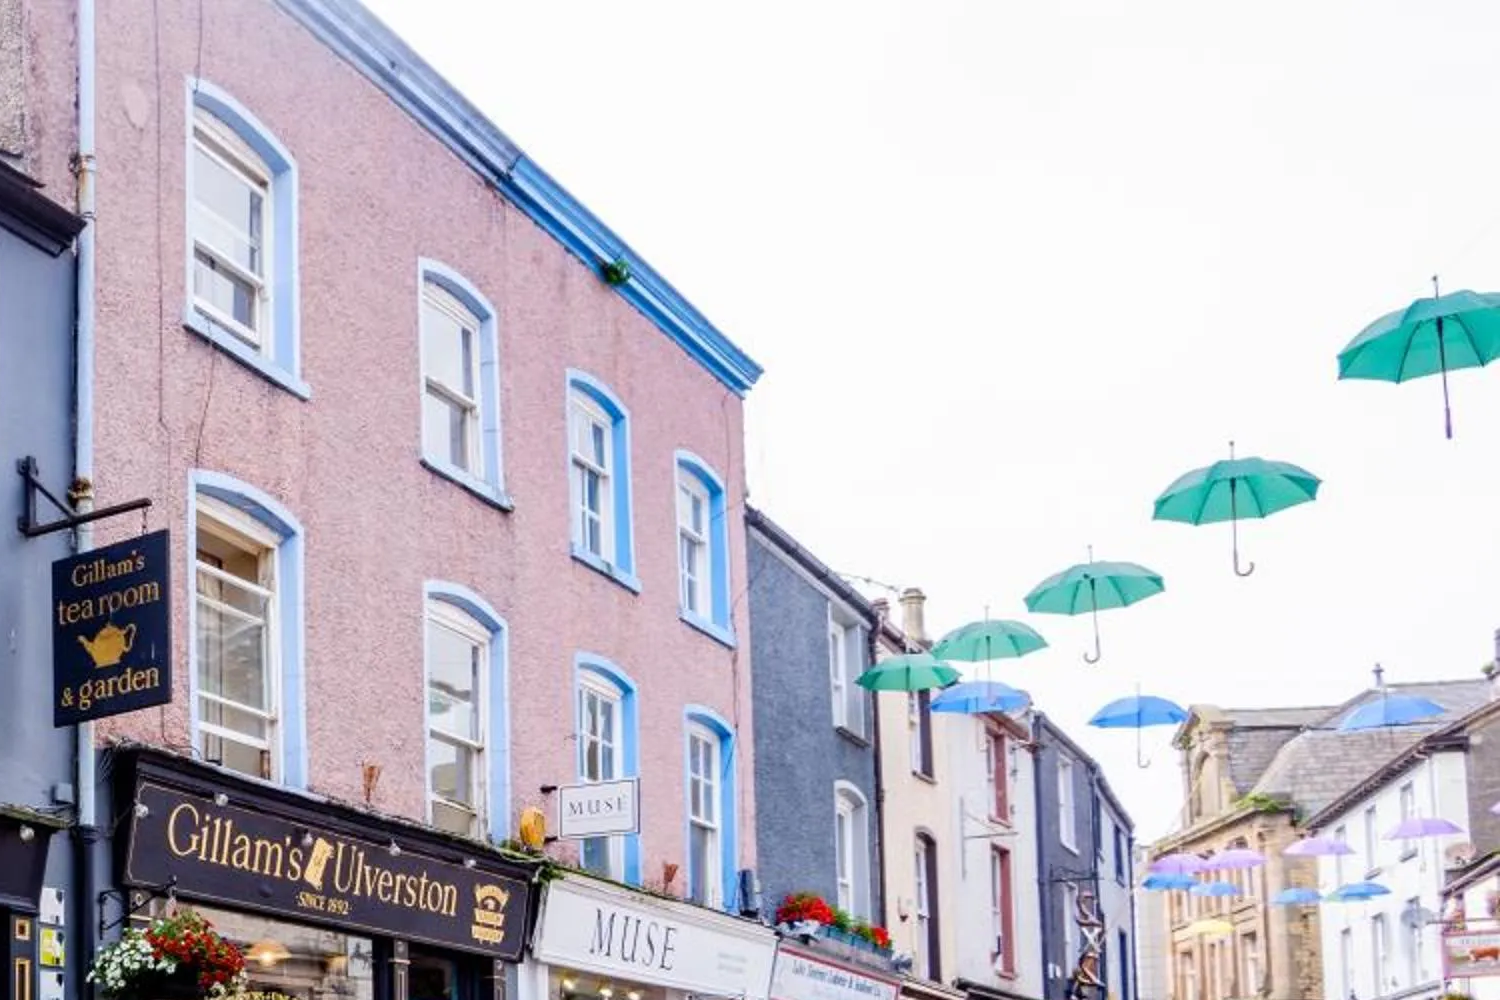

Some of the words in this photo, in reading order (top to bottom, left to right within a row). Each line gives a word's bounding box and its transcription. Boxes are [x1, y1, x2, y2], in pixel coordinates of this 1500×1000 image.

[71, 550, 145, 588] Gillam's
[60, 686, 74, 708] &
[78, 665, 161, 712] garden
[568, 793, 630, 817] MUSE
[167, 802, 302, 882] Gillam's
[333, 841, 459, 917] Ulverston
[589, 907, 677, 971] MUSE
